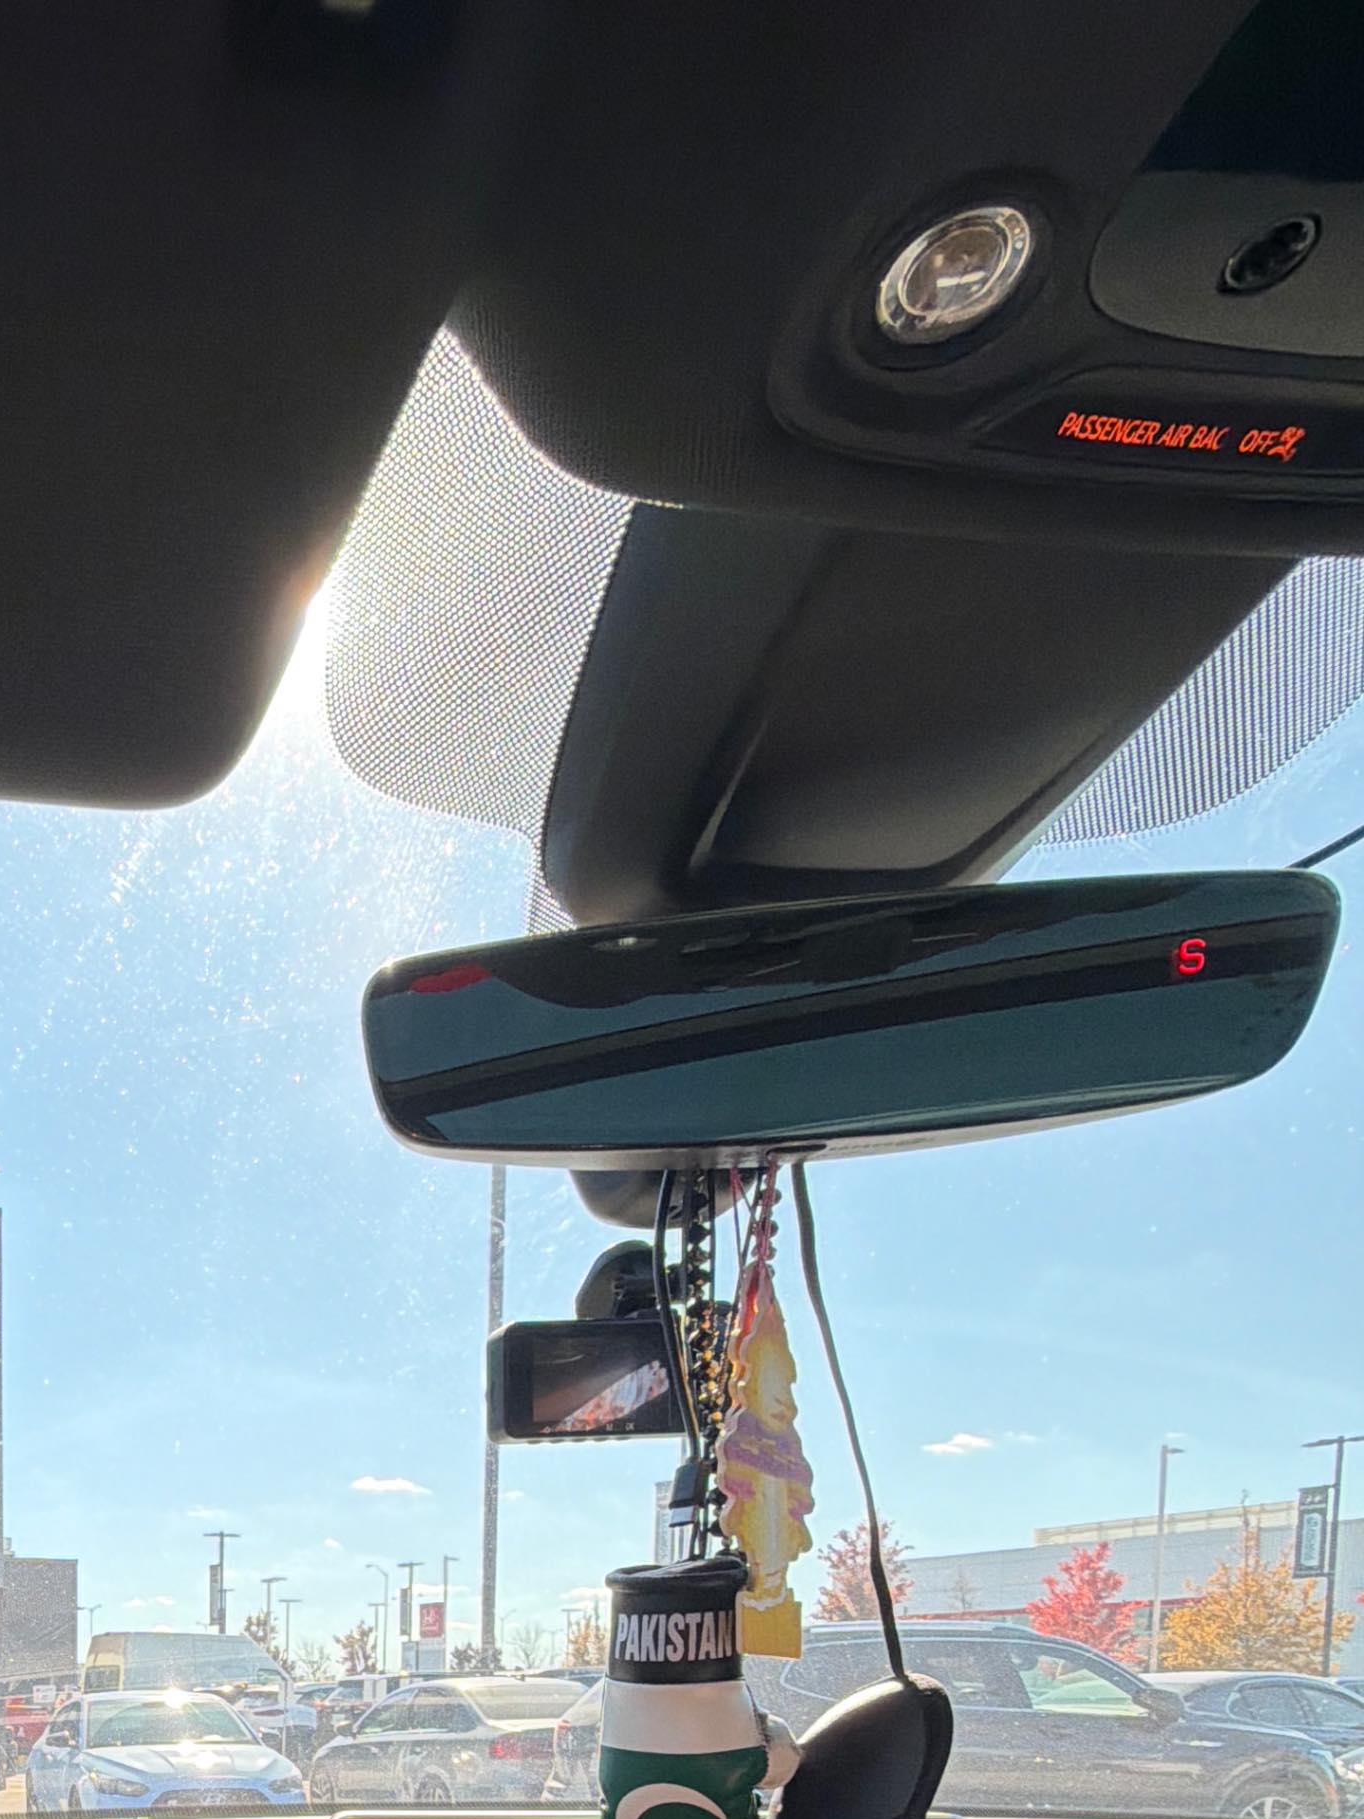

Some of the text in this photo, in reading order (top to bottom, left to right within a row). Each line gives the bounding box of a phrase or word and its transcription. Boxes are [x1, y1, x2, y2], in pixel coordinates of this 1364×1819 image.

[1057, 411, 1162, 444] PASSENGER
[1158, 424, 1193, 448] AIR
[1239, 430, 1275, 453] OFF
[614, 1610, 733, 1662] PAKISTAN
